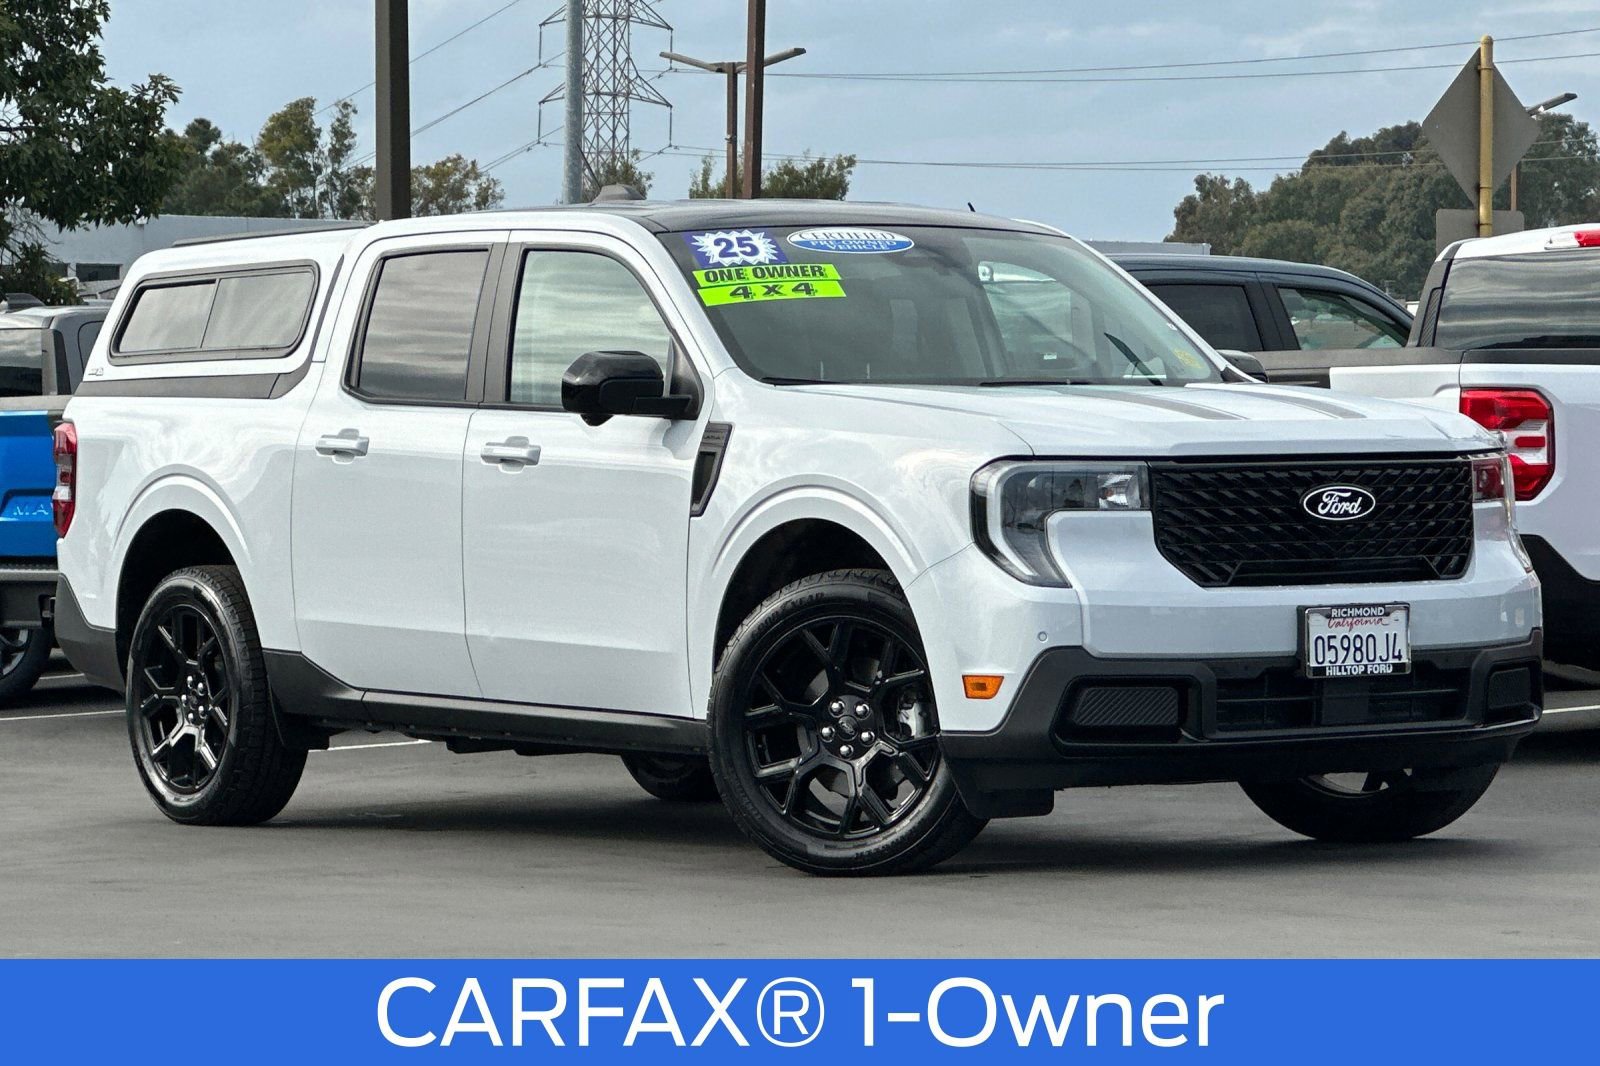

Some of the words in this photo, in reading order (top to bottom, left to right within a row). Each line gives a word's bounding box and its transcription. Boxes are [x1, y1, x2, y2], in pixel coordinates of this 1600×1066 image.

[799, 231, 896, 240] CERTIFIED
[713, 236, 760, 258] 25
[704, 267, 747, 284] ONE
[751, 264, 826, 281] OWNER
[1317, 490, 1363, 515] Ford
[1331, 606, 1385, 618] RICHMOND
[1327, 616, 1390, 632] California
[1314, 632, 1403, 665] 05980J4
[1325, 664, 1365, 676] HILLTOP
[1367, 663, 1393, 674] FORD
